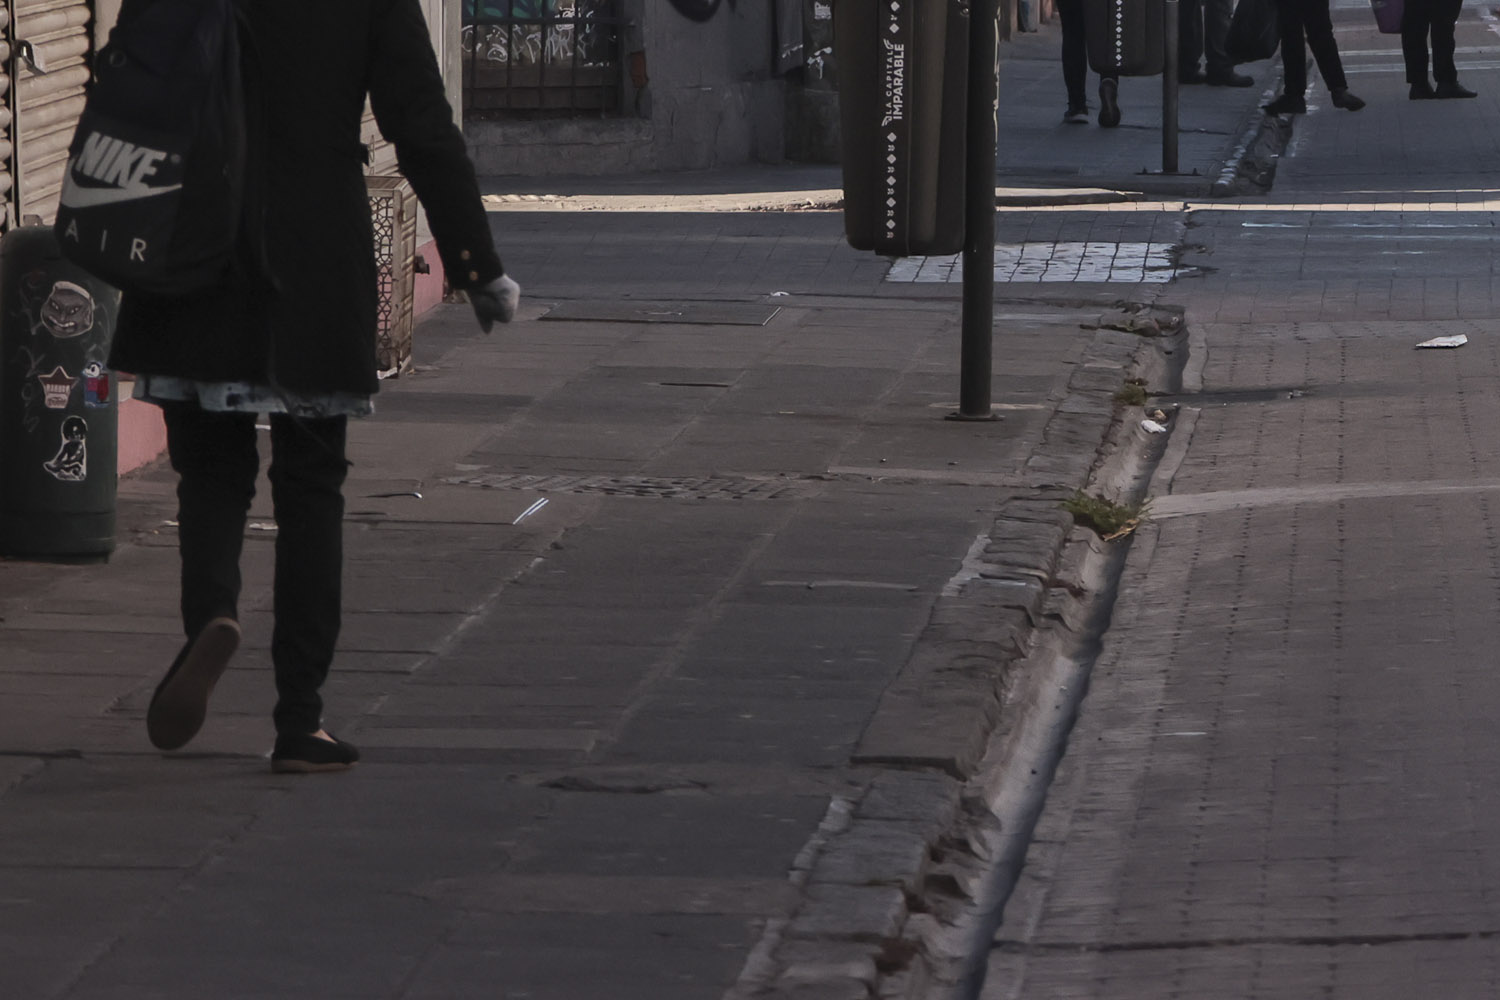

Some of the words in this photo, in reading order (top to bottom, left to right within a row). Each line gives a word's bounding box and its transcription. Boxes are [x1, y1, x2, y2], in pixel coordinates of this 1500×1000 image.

[885, 50, 894, 97] CAPITAL
[892, 43, 905, 120] IMPARABLE
[885, 102, 893, 115] LA
[75, 131, 167, 190] NIKE
